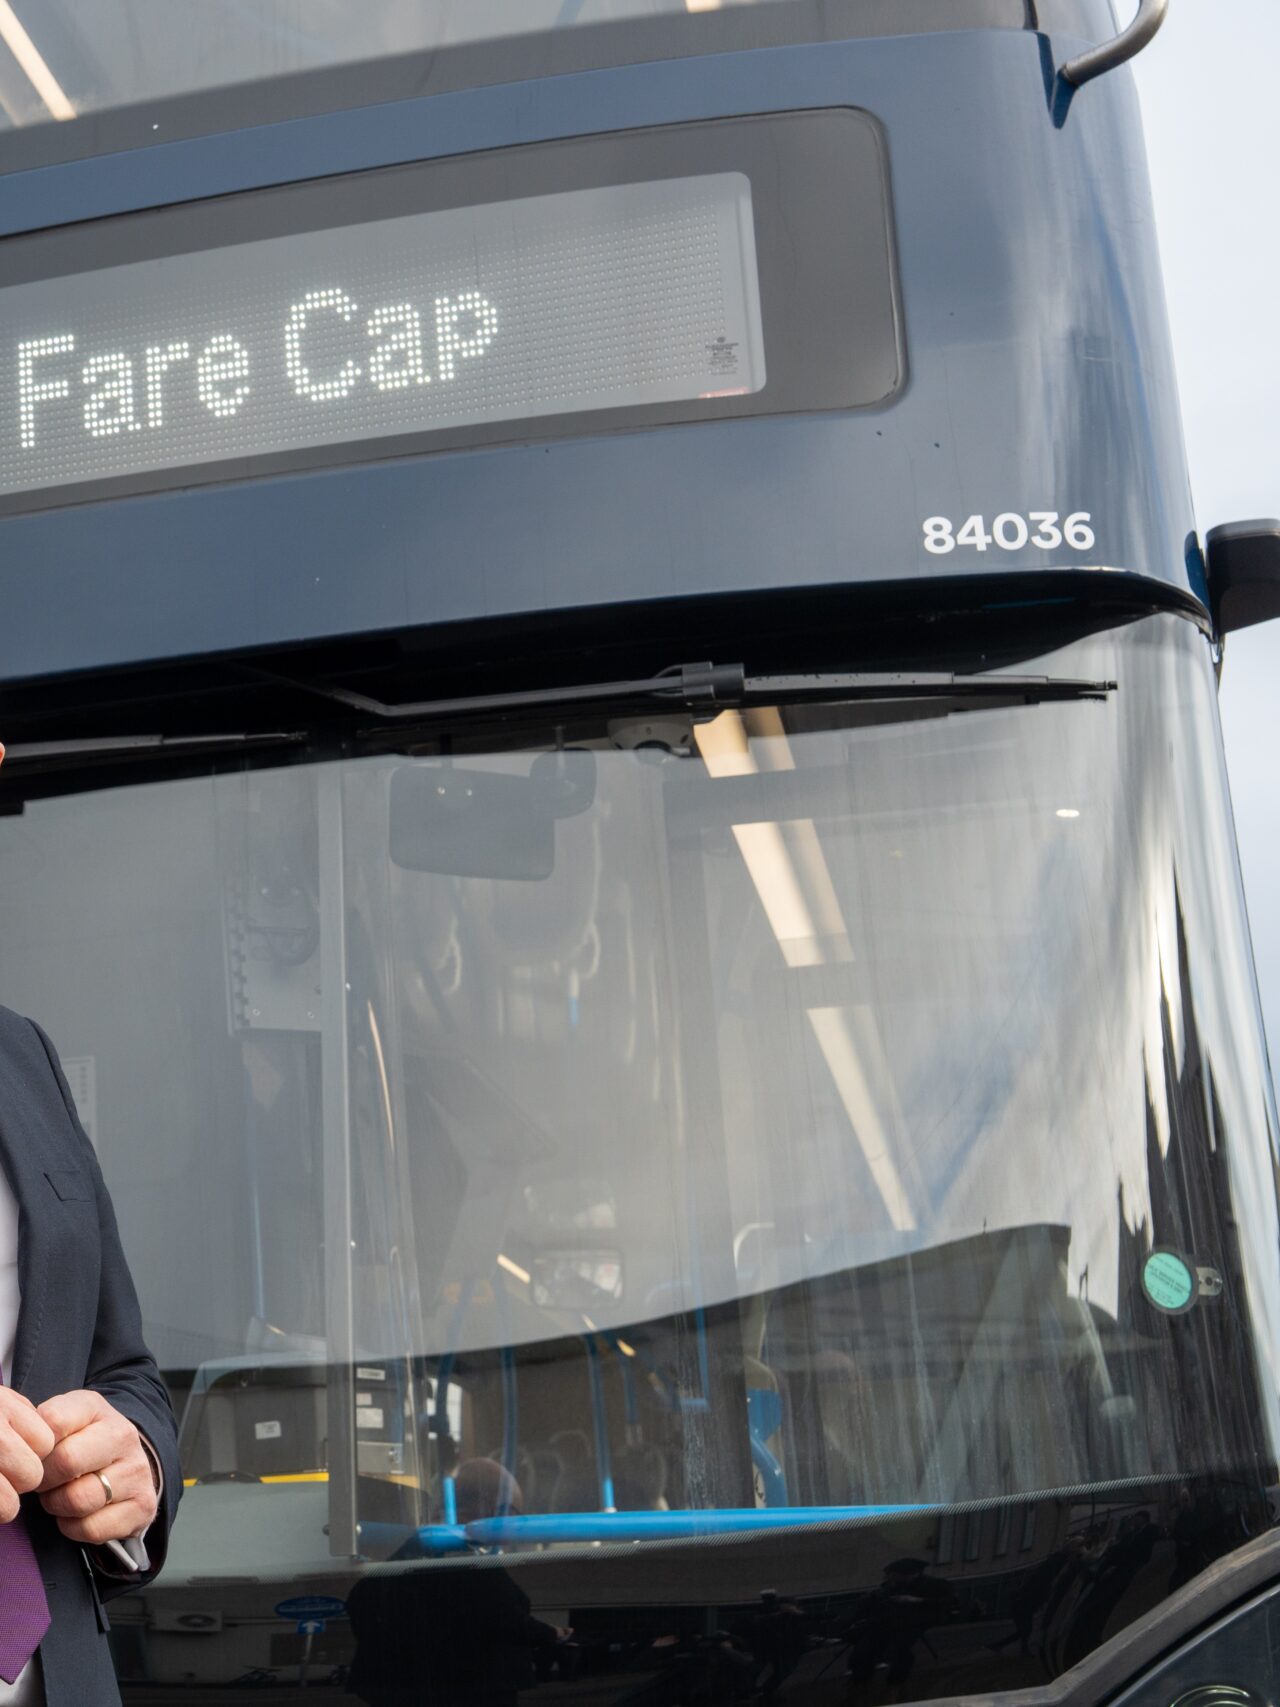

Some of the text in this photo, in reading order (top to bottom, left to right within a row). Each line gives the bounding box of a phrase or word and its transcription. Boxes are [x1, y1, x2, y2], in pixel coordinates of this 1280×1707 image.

[18, 334, 250, 448] Fare
[284, 288, 499, 401] Cap
[922, 511, 1096, 554] 84036
